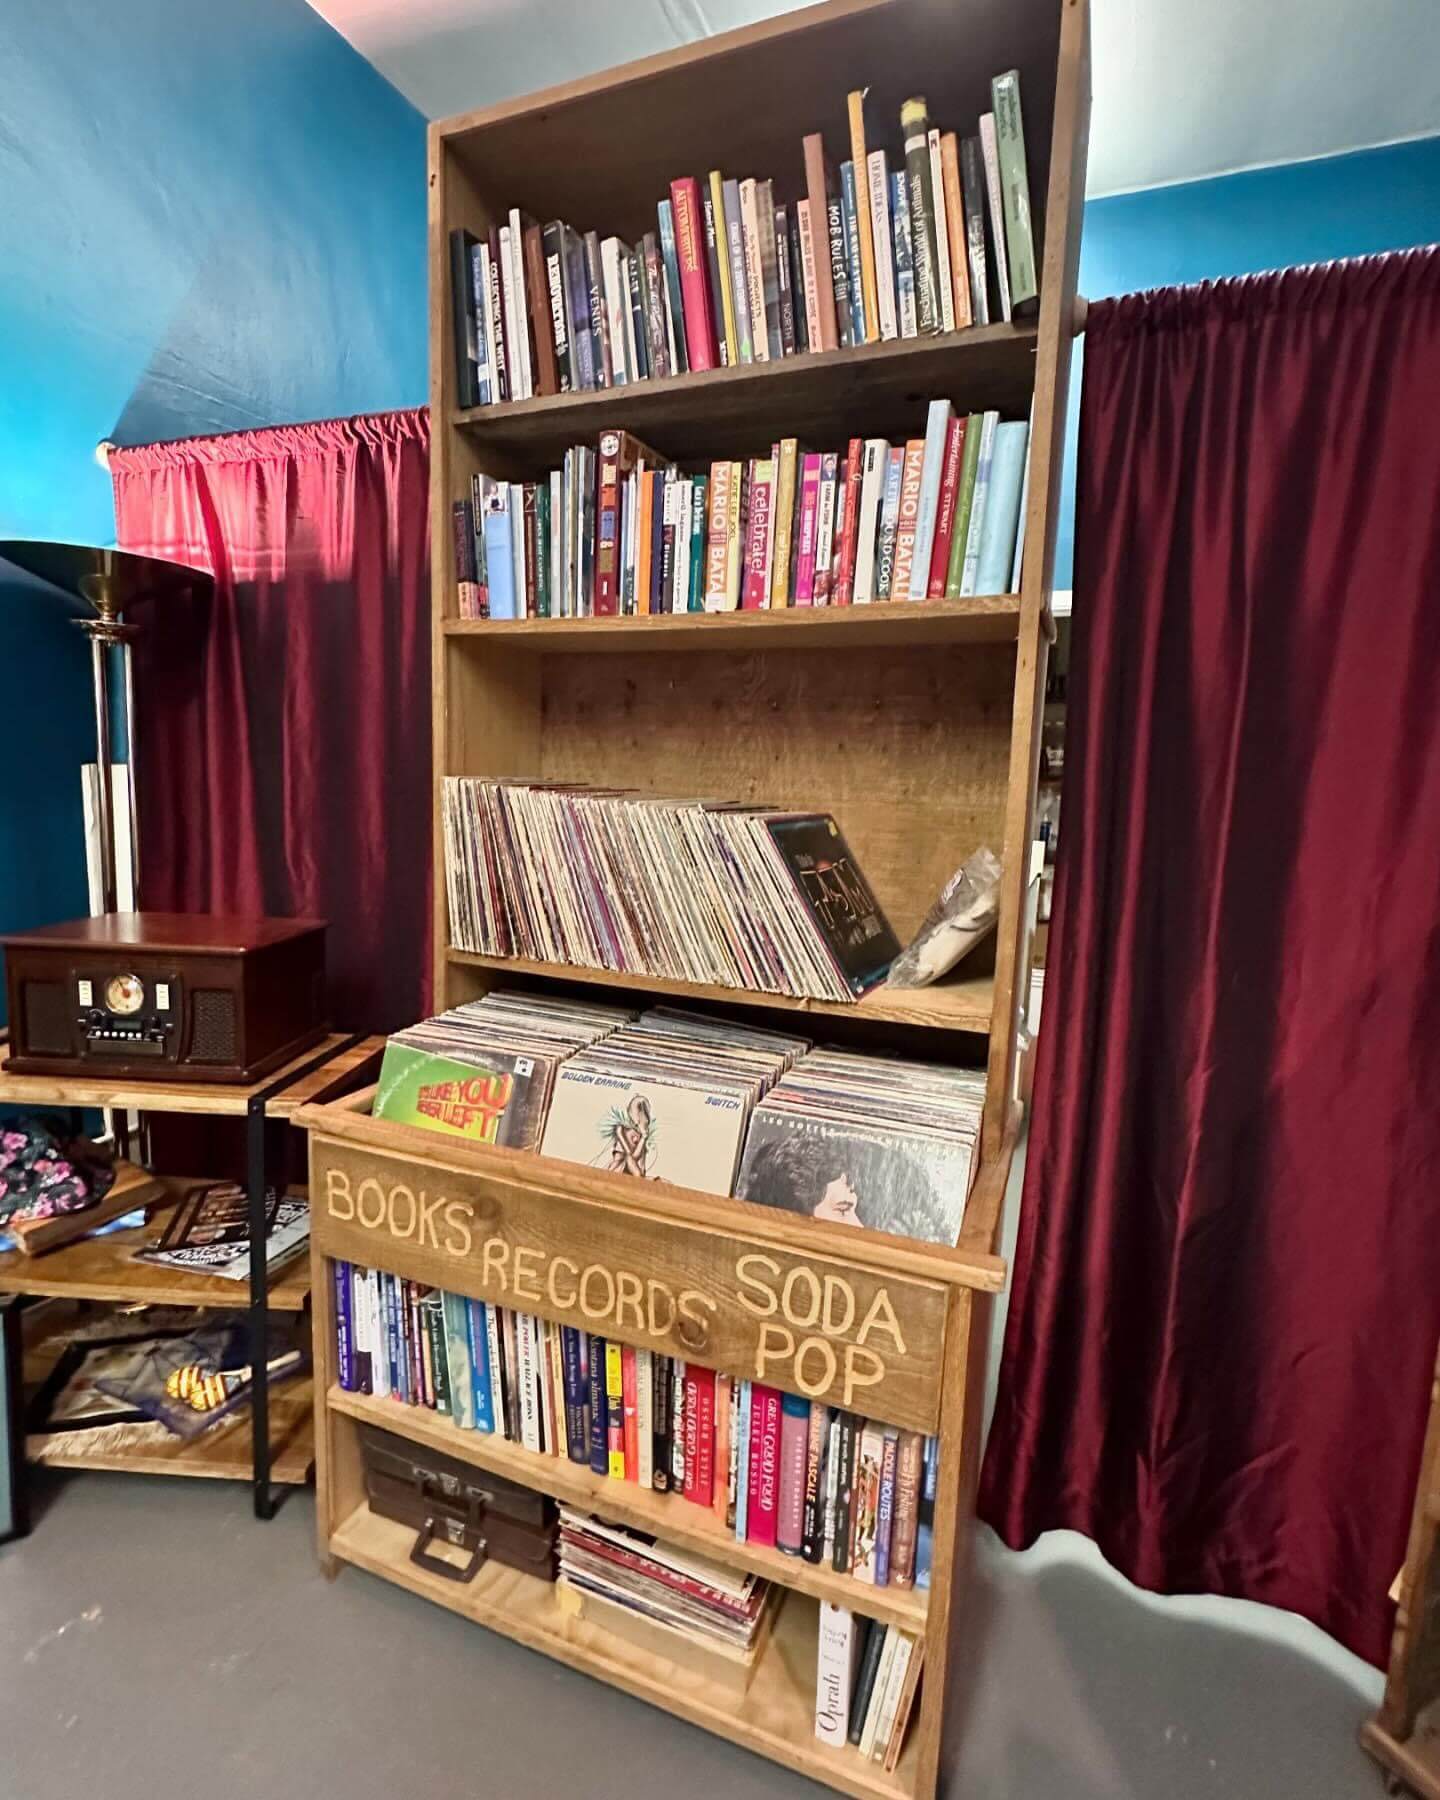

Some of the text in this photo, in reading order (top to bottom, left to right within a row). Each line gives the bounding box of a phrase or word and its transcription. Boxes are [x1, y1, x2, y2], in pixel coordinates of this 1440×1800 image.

[909, 174, 924, 218] Animals
[827, 205, 846, 280] MOB RULES
[913, 232, 927, 263] World
[587, 284, 603, 336] VENUS
[781, 302, 793, 339] NORTH
[915, 263, 931, 326] Fascinating
[711, 466, 729, 530] MARIO
[729, 501, 737, 515] LEE
[938, 421, 964, 534] Entertaining STEWART
[663, 526, 672, 543] TV
[750, 487, 767, 576] celebrate!
[895, 451, 920, 599] MARIO BATALI
[878, 555, 892, 592] COOK
[460, 1072, 513, 1110] YOU
[561, 1071, 632, 1090] GOLDEN EARRING
[705, 1096, 740, 1110] SWITCH
[445, 1103, 498, 1137] LEFT
[326, 1170, 474, 1257] BOOKS
[483, 1238, 717, 1349] RECORDS
[736, 1253, 906, 1354] SODA
[589, 1335, 601, 1422] Montana almanac
[756, 1323, 885, 1405] POP
[683, 1381, 698, 1489] GREAT GOOD FOOD
[701, 1447, 709, 1485] JULEE
[749, 1403, 760, 1495] JULEE ROSSO
[760, 1397, 776, 1512] GREAT GOOD FOOD
[806, 1453, 818, 1502] PASCALE
[879, 1440, 895, 1520] PADDLE ROUTES
[817, 1673, 844, 1732] Oprah
